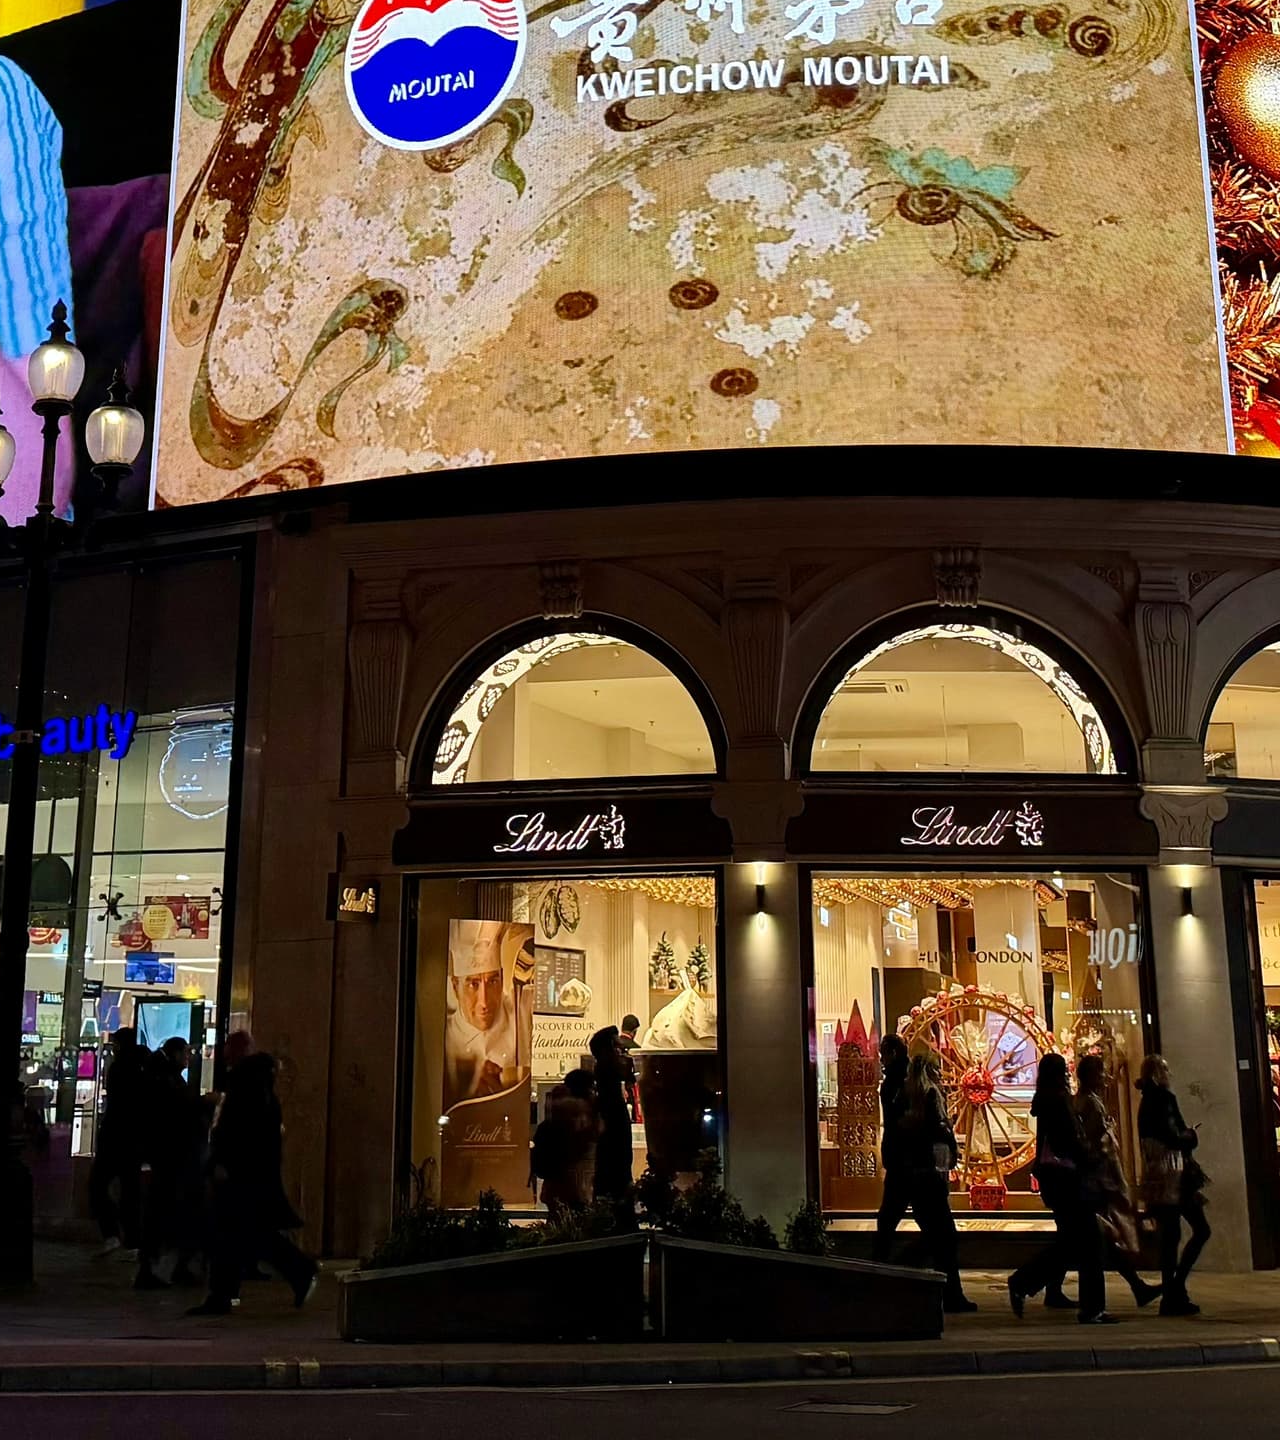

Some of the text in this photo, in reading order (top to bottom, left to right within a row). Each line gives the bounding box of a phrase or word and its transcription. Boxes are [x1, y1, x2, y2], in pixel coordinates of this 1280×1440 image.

[387, 68, 476, 105] MOUTAI
[575, 54, 951, 104] KWEICHOW MOUTAI
[493, 812, 600, 852] Lindt
[901, 806, 1013, 847] Lindt
[535, 1021, 595, 1031] ISCOVER OUR
[464, 1123, 502, 1142] Lindt
